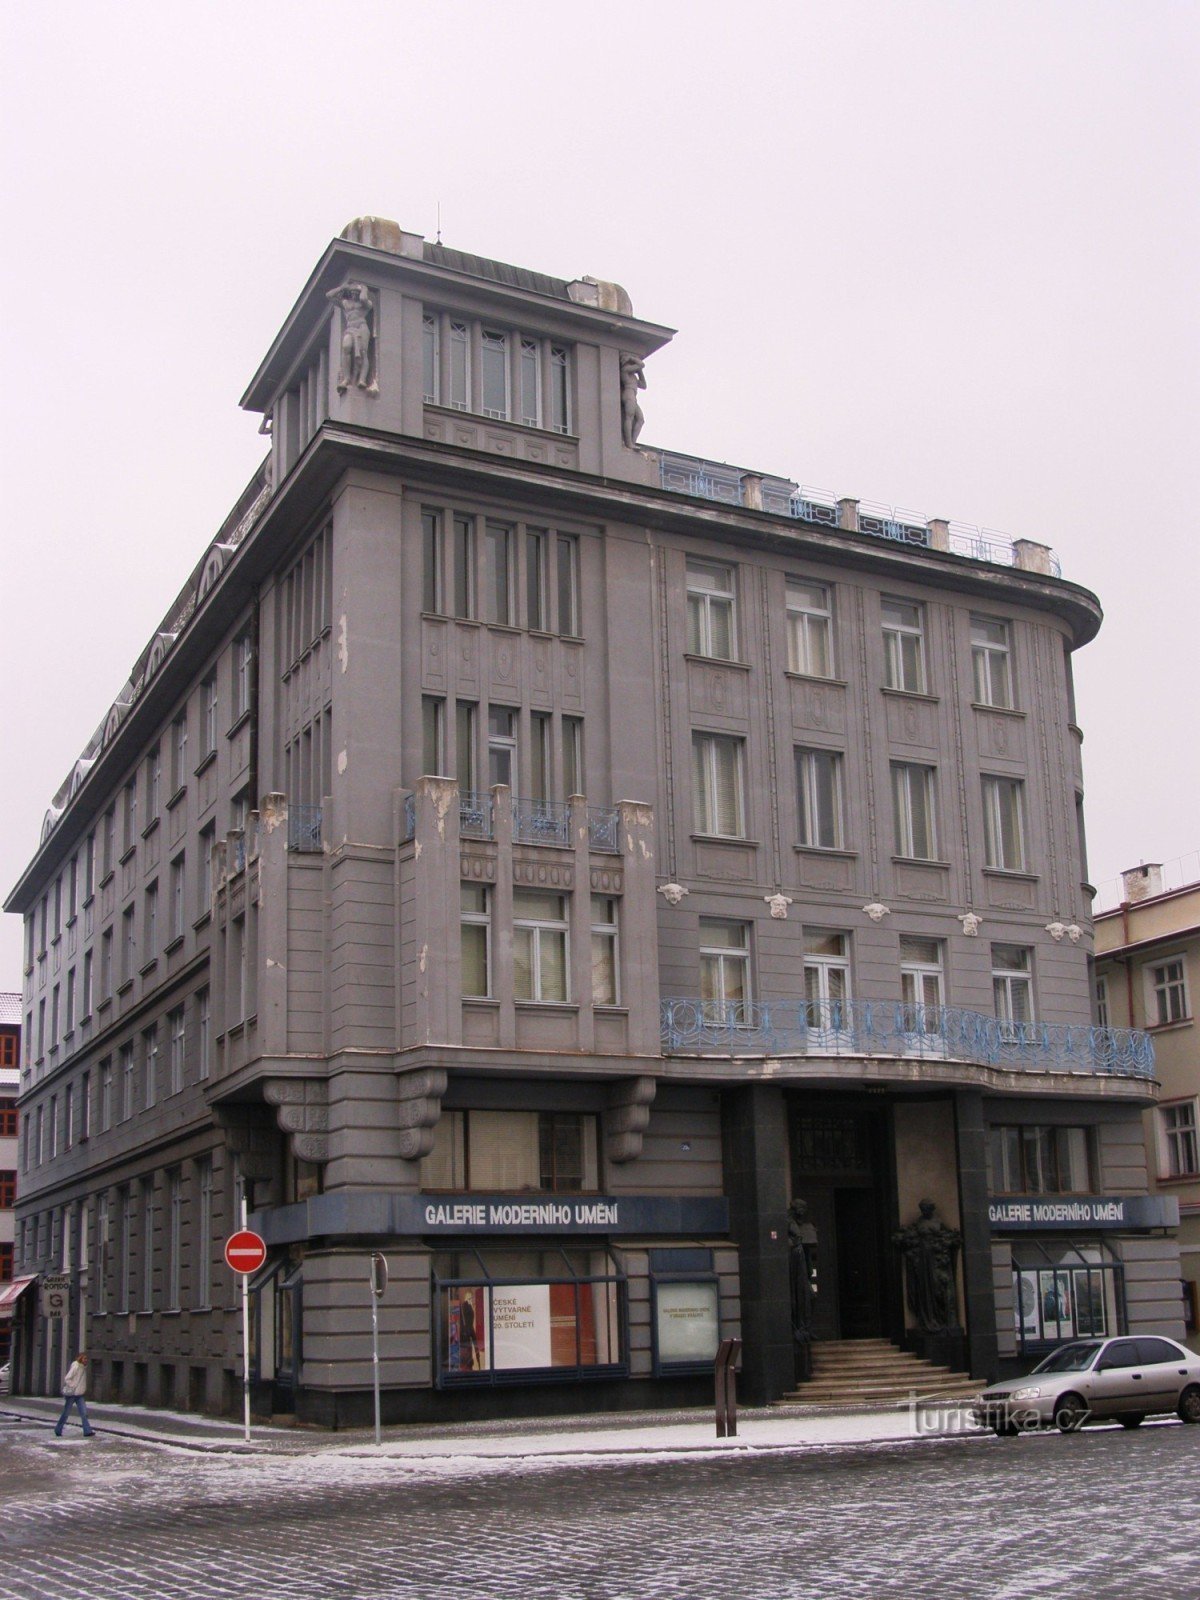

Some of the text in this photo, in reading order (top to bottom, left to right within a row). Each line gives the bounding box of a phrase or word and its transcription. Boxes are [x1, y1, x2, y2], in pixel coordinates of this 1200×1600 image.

[425, 1203, 619, 1225] GALERIE MODERNÍHO UMĚNÍ
[988, 1202, 1124, 1222] GALERIE MODERNÍHO UMĚNÍ
[504, 1320, 534, 1329] STOLETÍ
